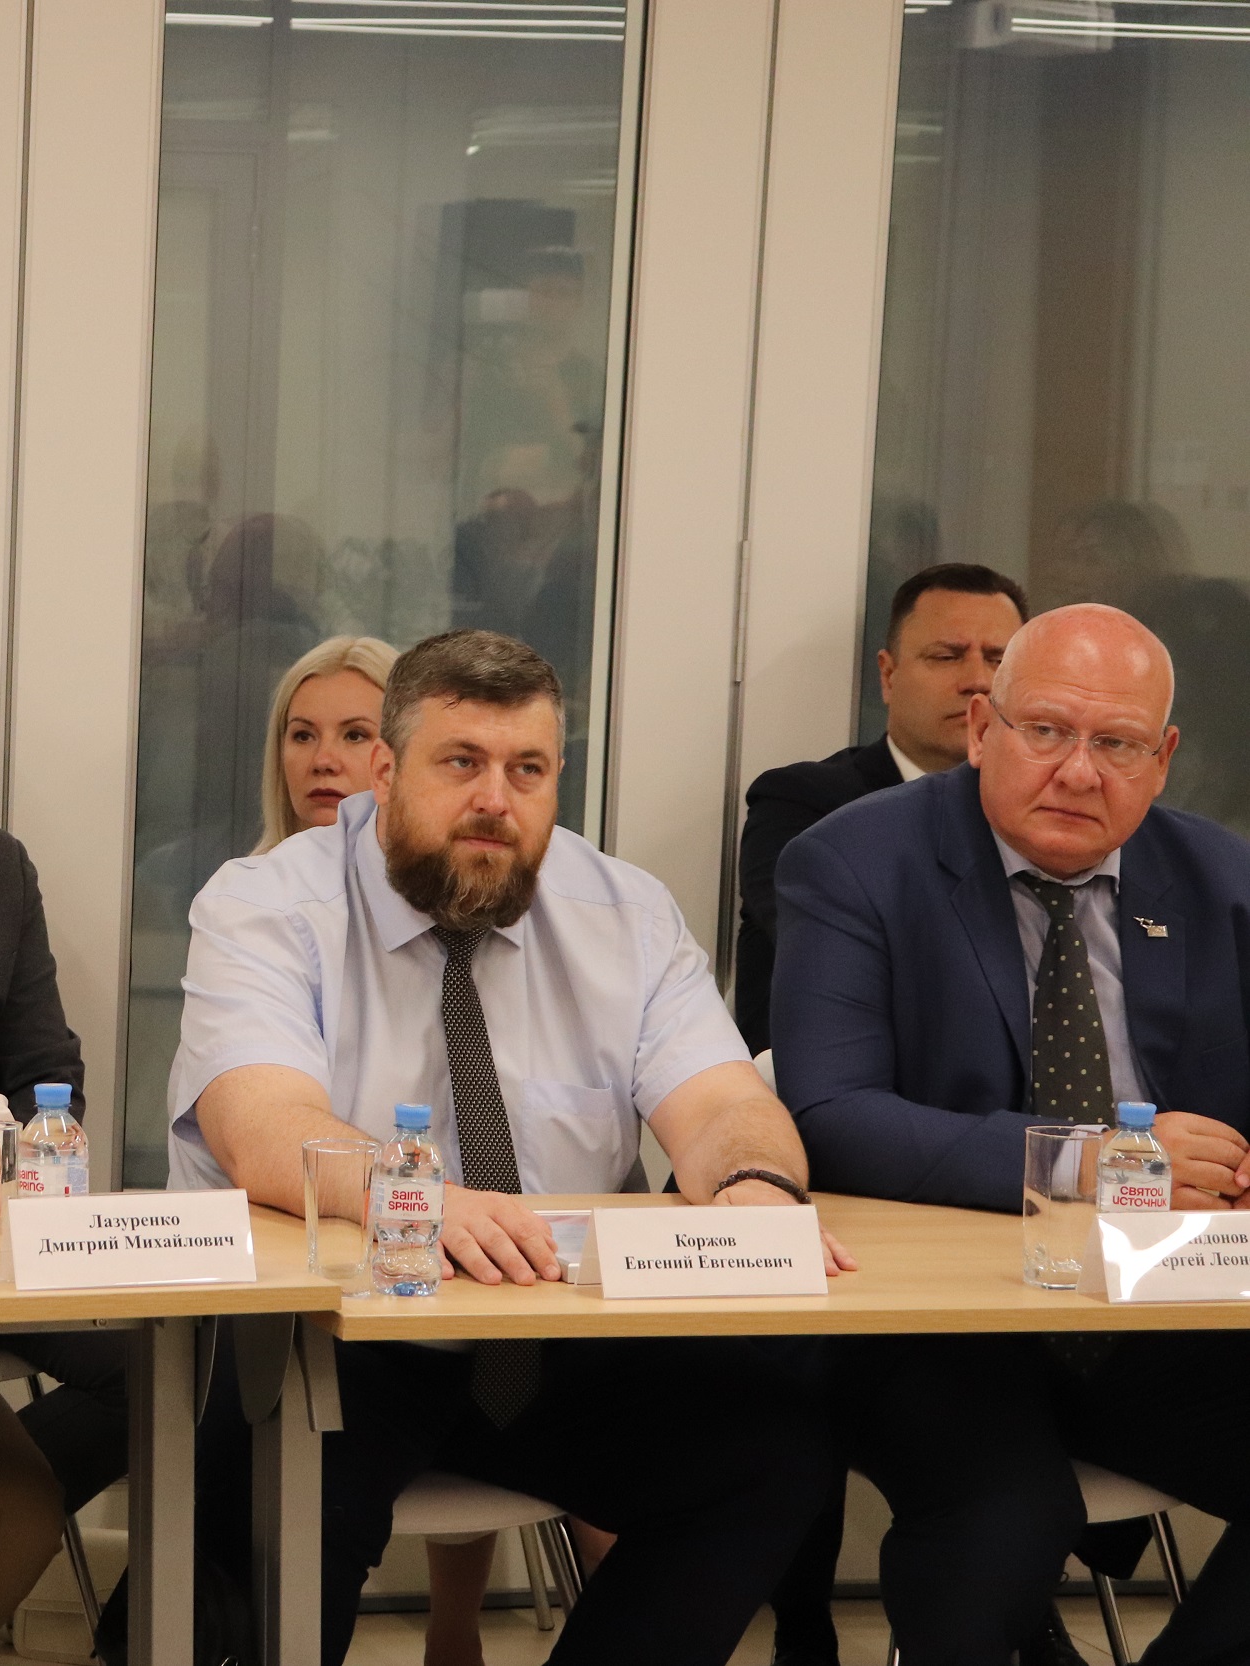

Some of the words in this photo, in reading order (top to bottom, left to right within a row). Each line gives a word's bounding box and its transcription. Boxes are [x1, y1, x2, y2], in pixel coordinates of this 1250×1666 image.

[19, 1169, 39, 1181] aint
[19, 1181, 45, 1192] PRING
[1120, 1185, 1164, 1197] СВЯТОЙ
[1112, 1195, 1167, 1208] ИСТОЧНИК
[89, 1213, 180, 1231] Лазуренко
[38, 1236, 119, 1256] Дмитрий
[124, 1234, 235, 1251] Михайлович
[675, 1233, 737, 1251] Коржов
[1188, 1233, 1248, 1246] ндонов
[625, 1255, 693, 1270] Евгений
[698, 1254, 793, 1270] Евгеньевич
[1154, 1252, 1205, 1271] ергей
[1210, 1251, 1250, 1267] Леон
